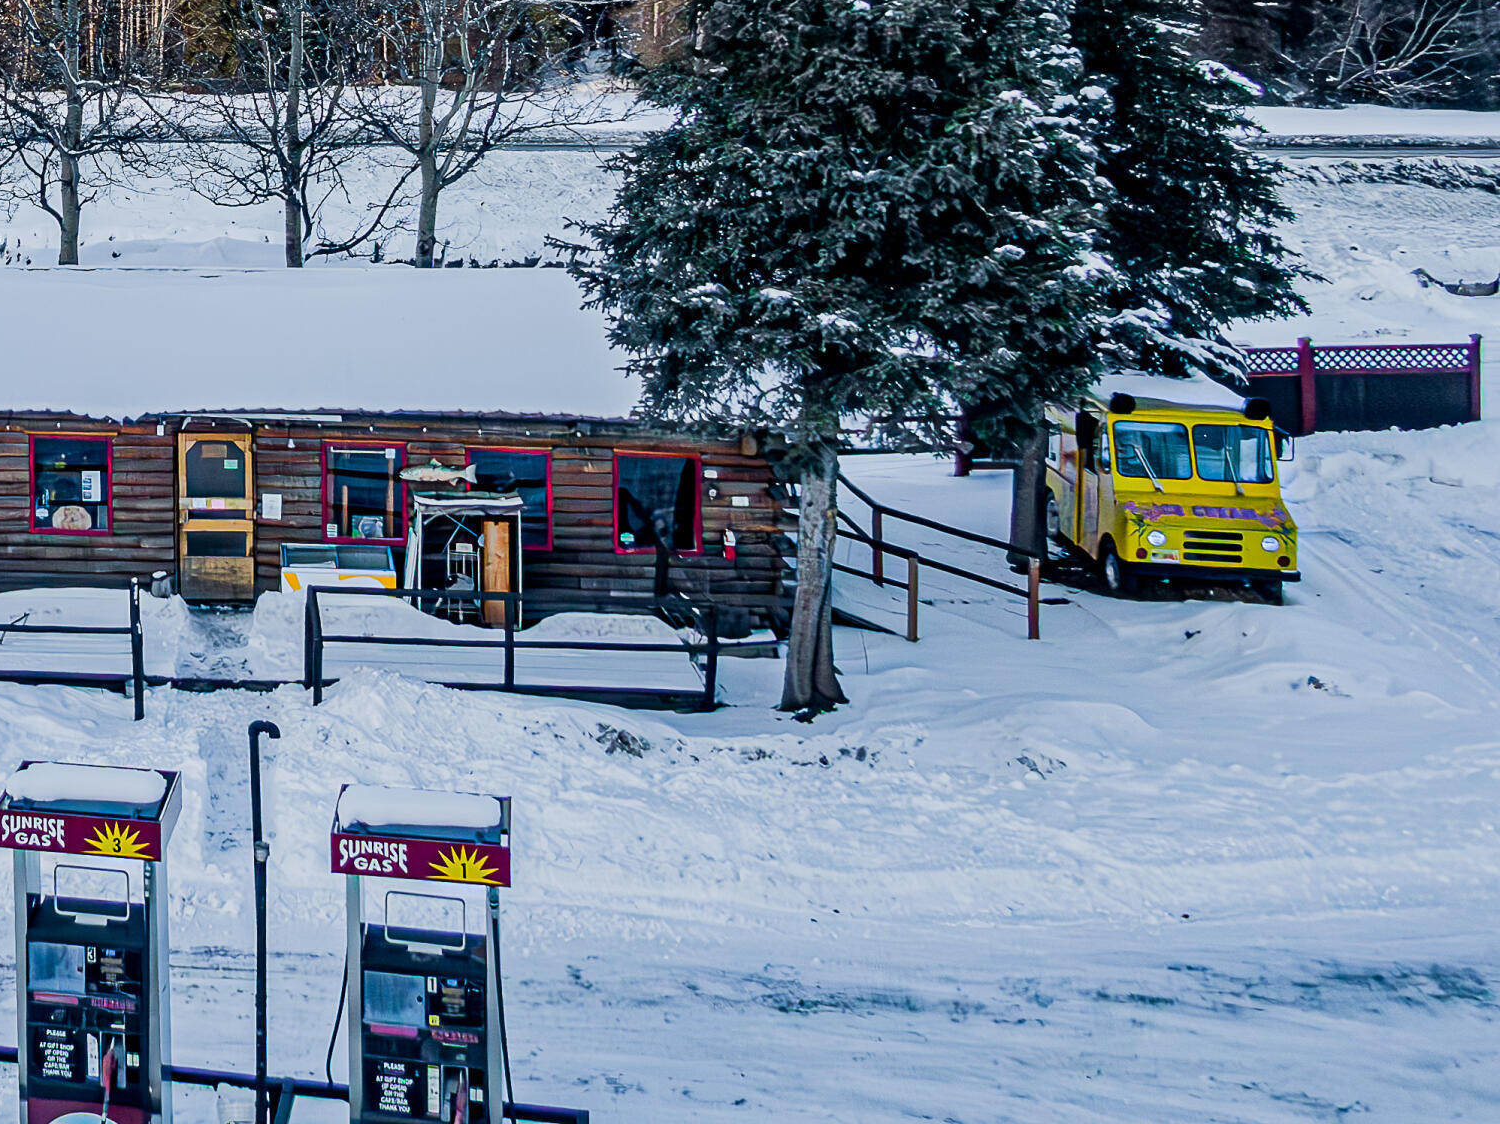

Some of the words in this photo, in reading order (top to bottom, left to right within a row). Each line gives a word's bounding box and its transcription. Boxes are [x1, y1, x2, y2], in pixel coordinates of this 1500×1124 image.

[1, 814, 65, 848] SUNRISE
[14, 832, 51, 847] GAS
[112, 837, 121, 853] 3
[339, 839, 408, 874] SUNRISE
[353, 857, 393, 873] GAS
[461, 862, 467, 879] 1
[46, 1029, 67, 1037] PLEASE
[383, 1062, 405, 1071] PLEASE
[379, 1103, 398, 1112] THANK
[398, 1105, 411, 1114] YOU
